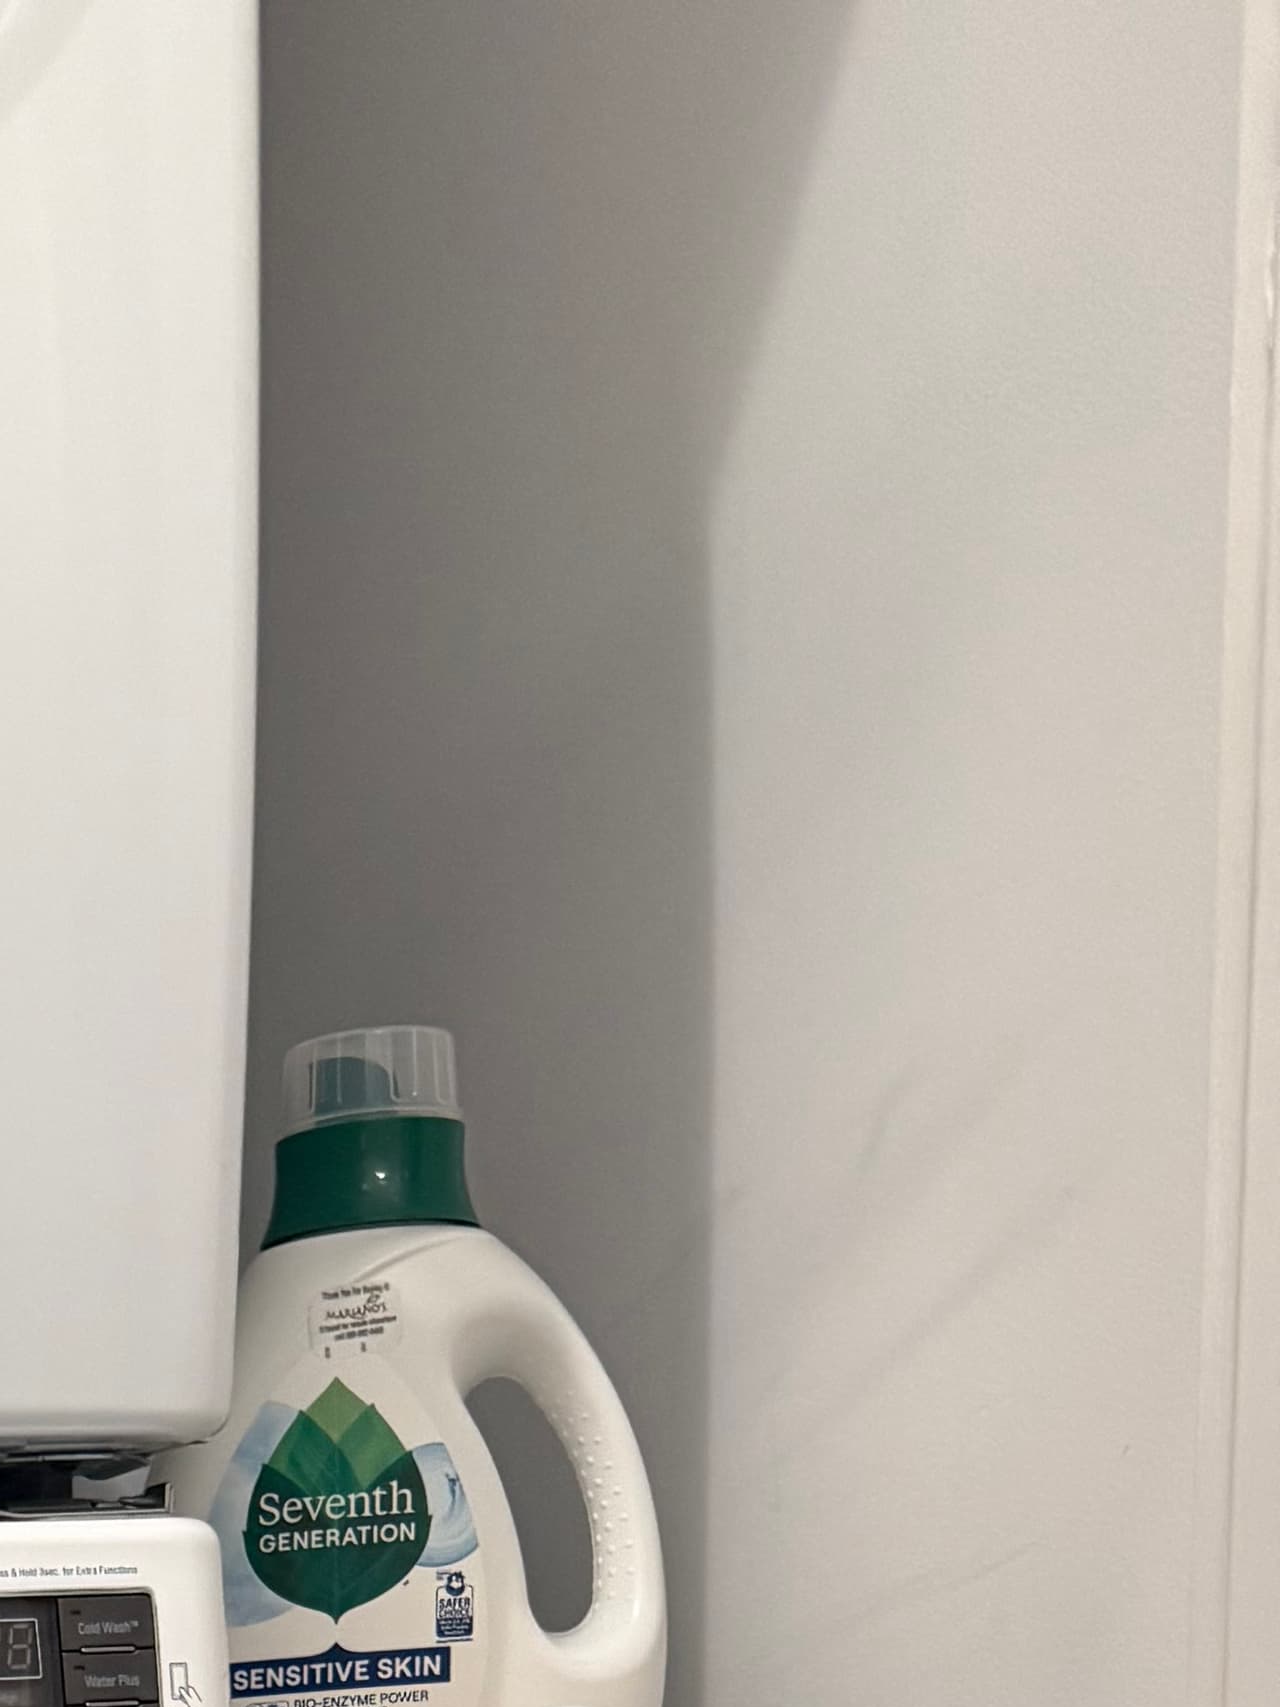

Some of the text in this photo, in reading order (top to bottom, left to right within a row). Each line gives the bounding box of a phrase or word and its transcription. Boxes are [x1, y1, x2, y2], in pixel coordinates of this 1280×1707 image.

[258, 1480, 416, 1526] Seventh
[259, 1522, 416, 1554] GENERATION
[78, 1622, 101, 1635] Cold
[84, 1674, 140, 1688] Water Plus
[233, 1654, 441, 1691] SENSITIVE SKIN
[380, 1690, 429, 1704] POWER
